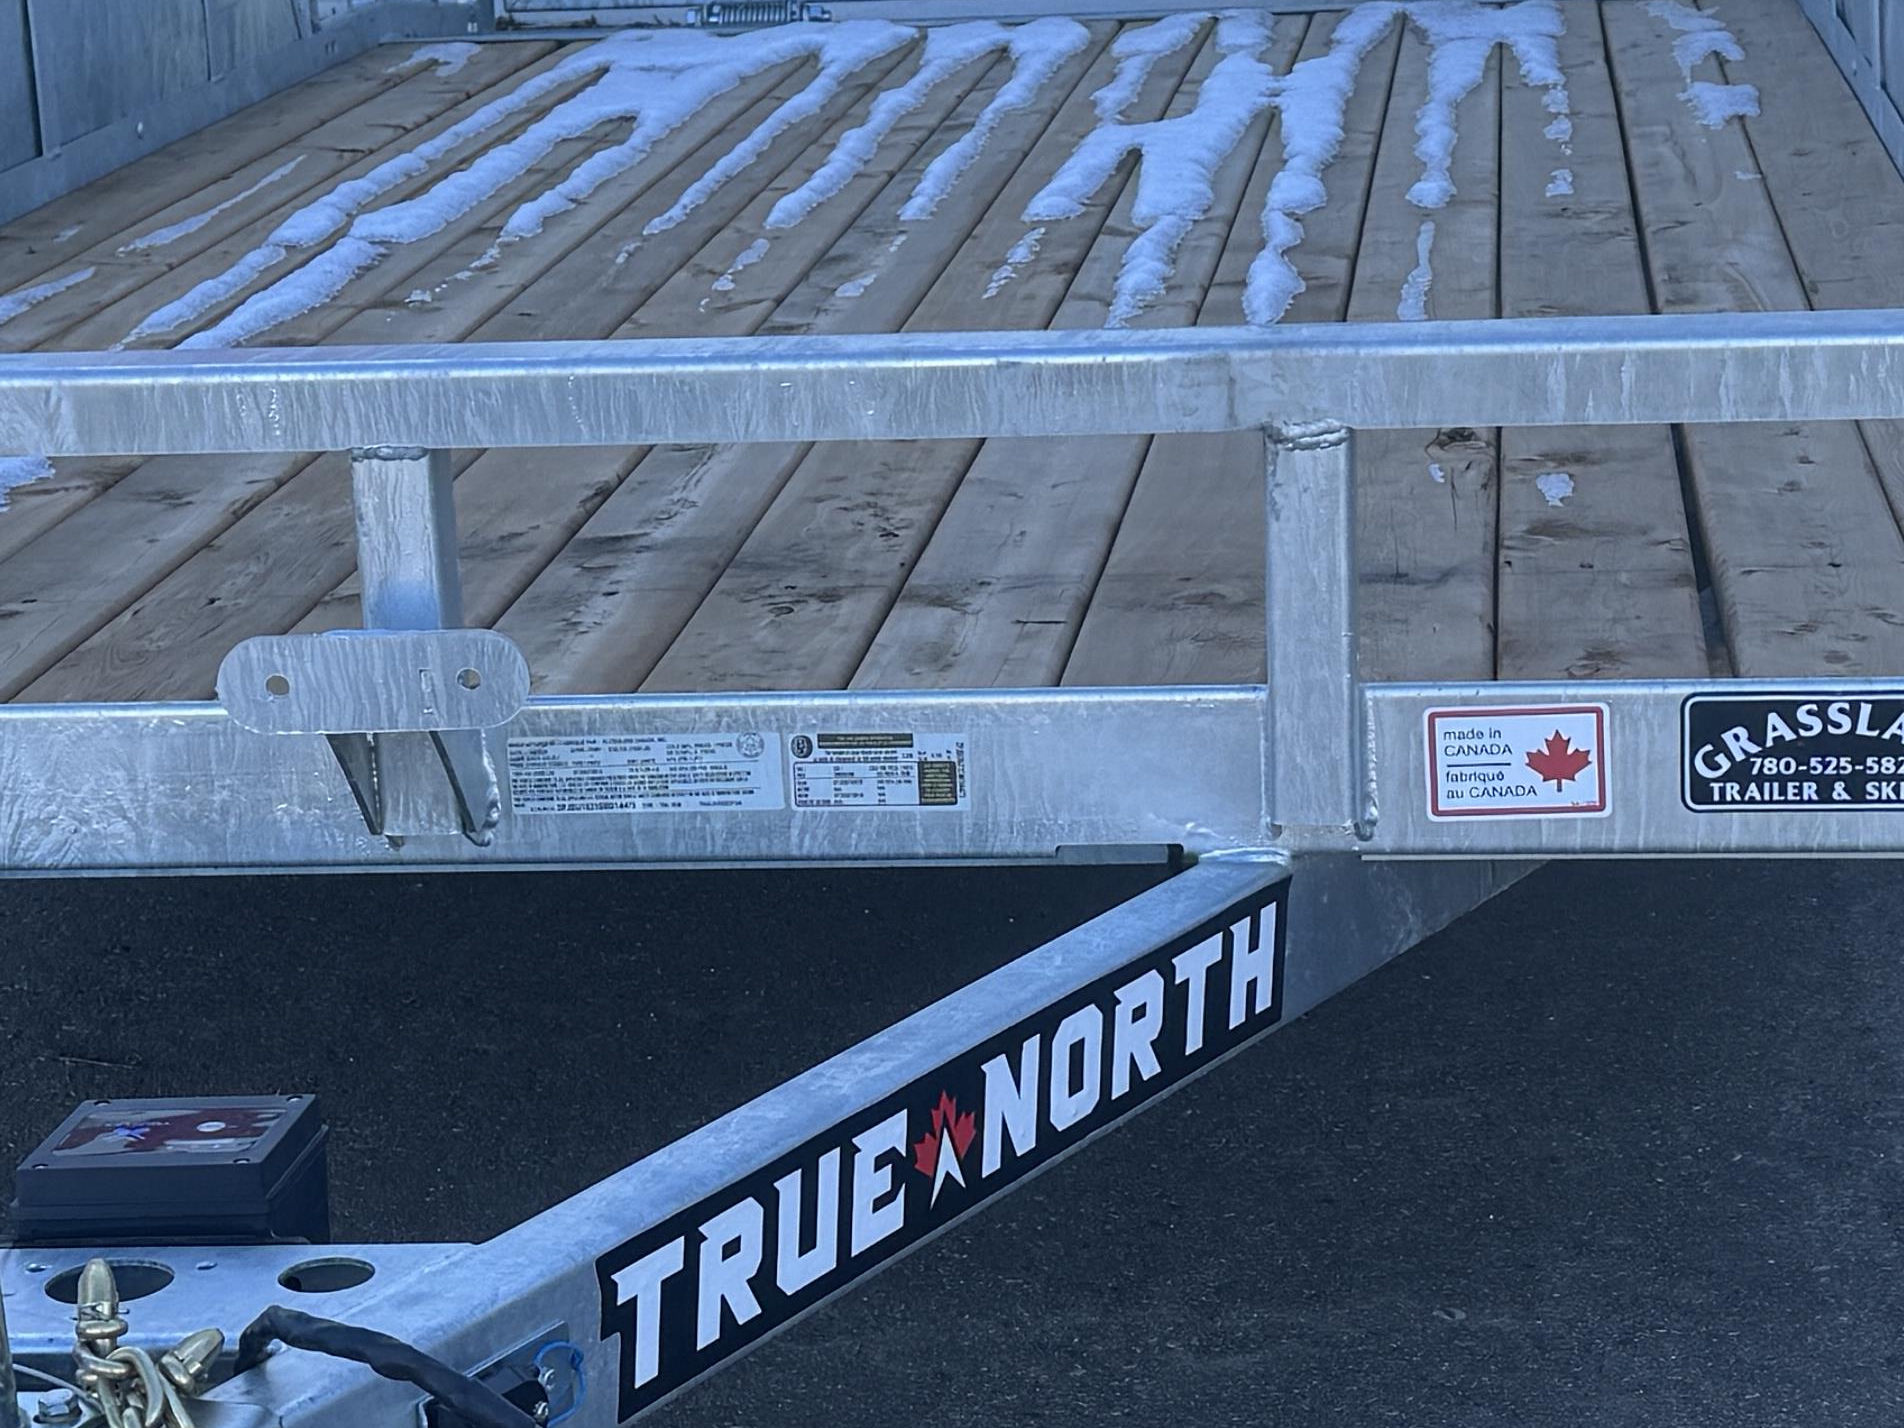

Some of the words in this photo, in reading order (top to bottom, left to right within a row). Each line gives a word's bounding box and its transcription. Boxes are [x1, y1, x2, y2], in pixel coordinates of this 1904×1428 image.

[1443, 727, 1484, 741] made
[1489, 727, 1502, 740] in
[1444, 743, 1513, 757] CANADA
[1446, 789, 1464, 799] au
[1469, 785, 1538, 799] CANADA
[1709, 781, 1819, 802] TRAILER
[1832, 781, 1852, 801] &
[610, 1108, 907, 1390] TRUE
[981, 900, 1278, 1179] NORTH
